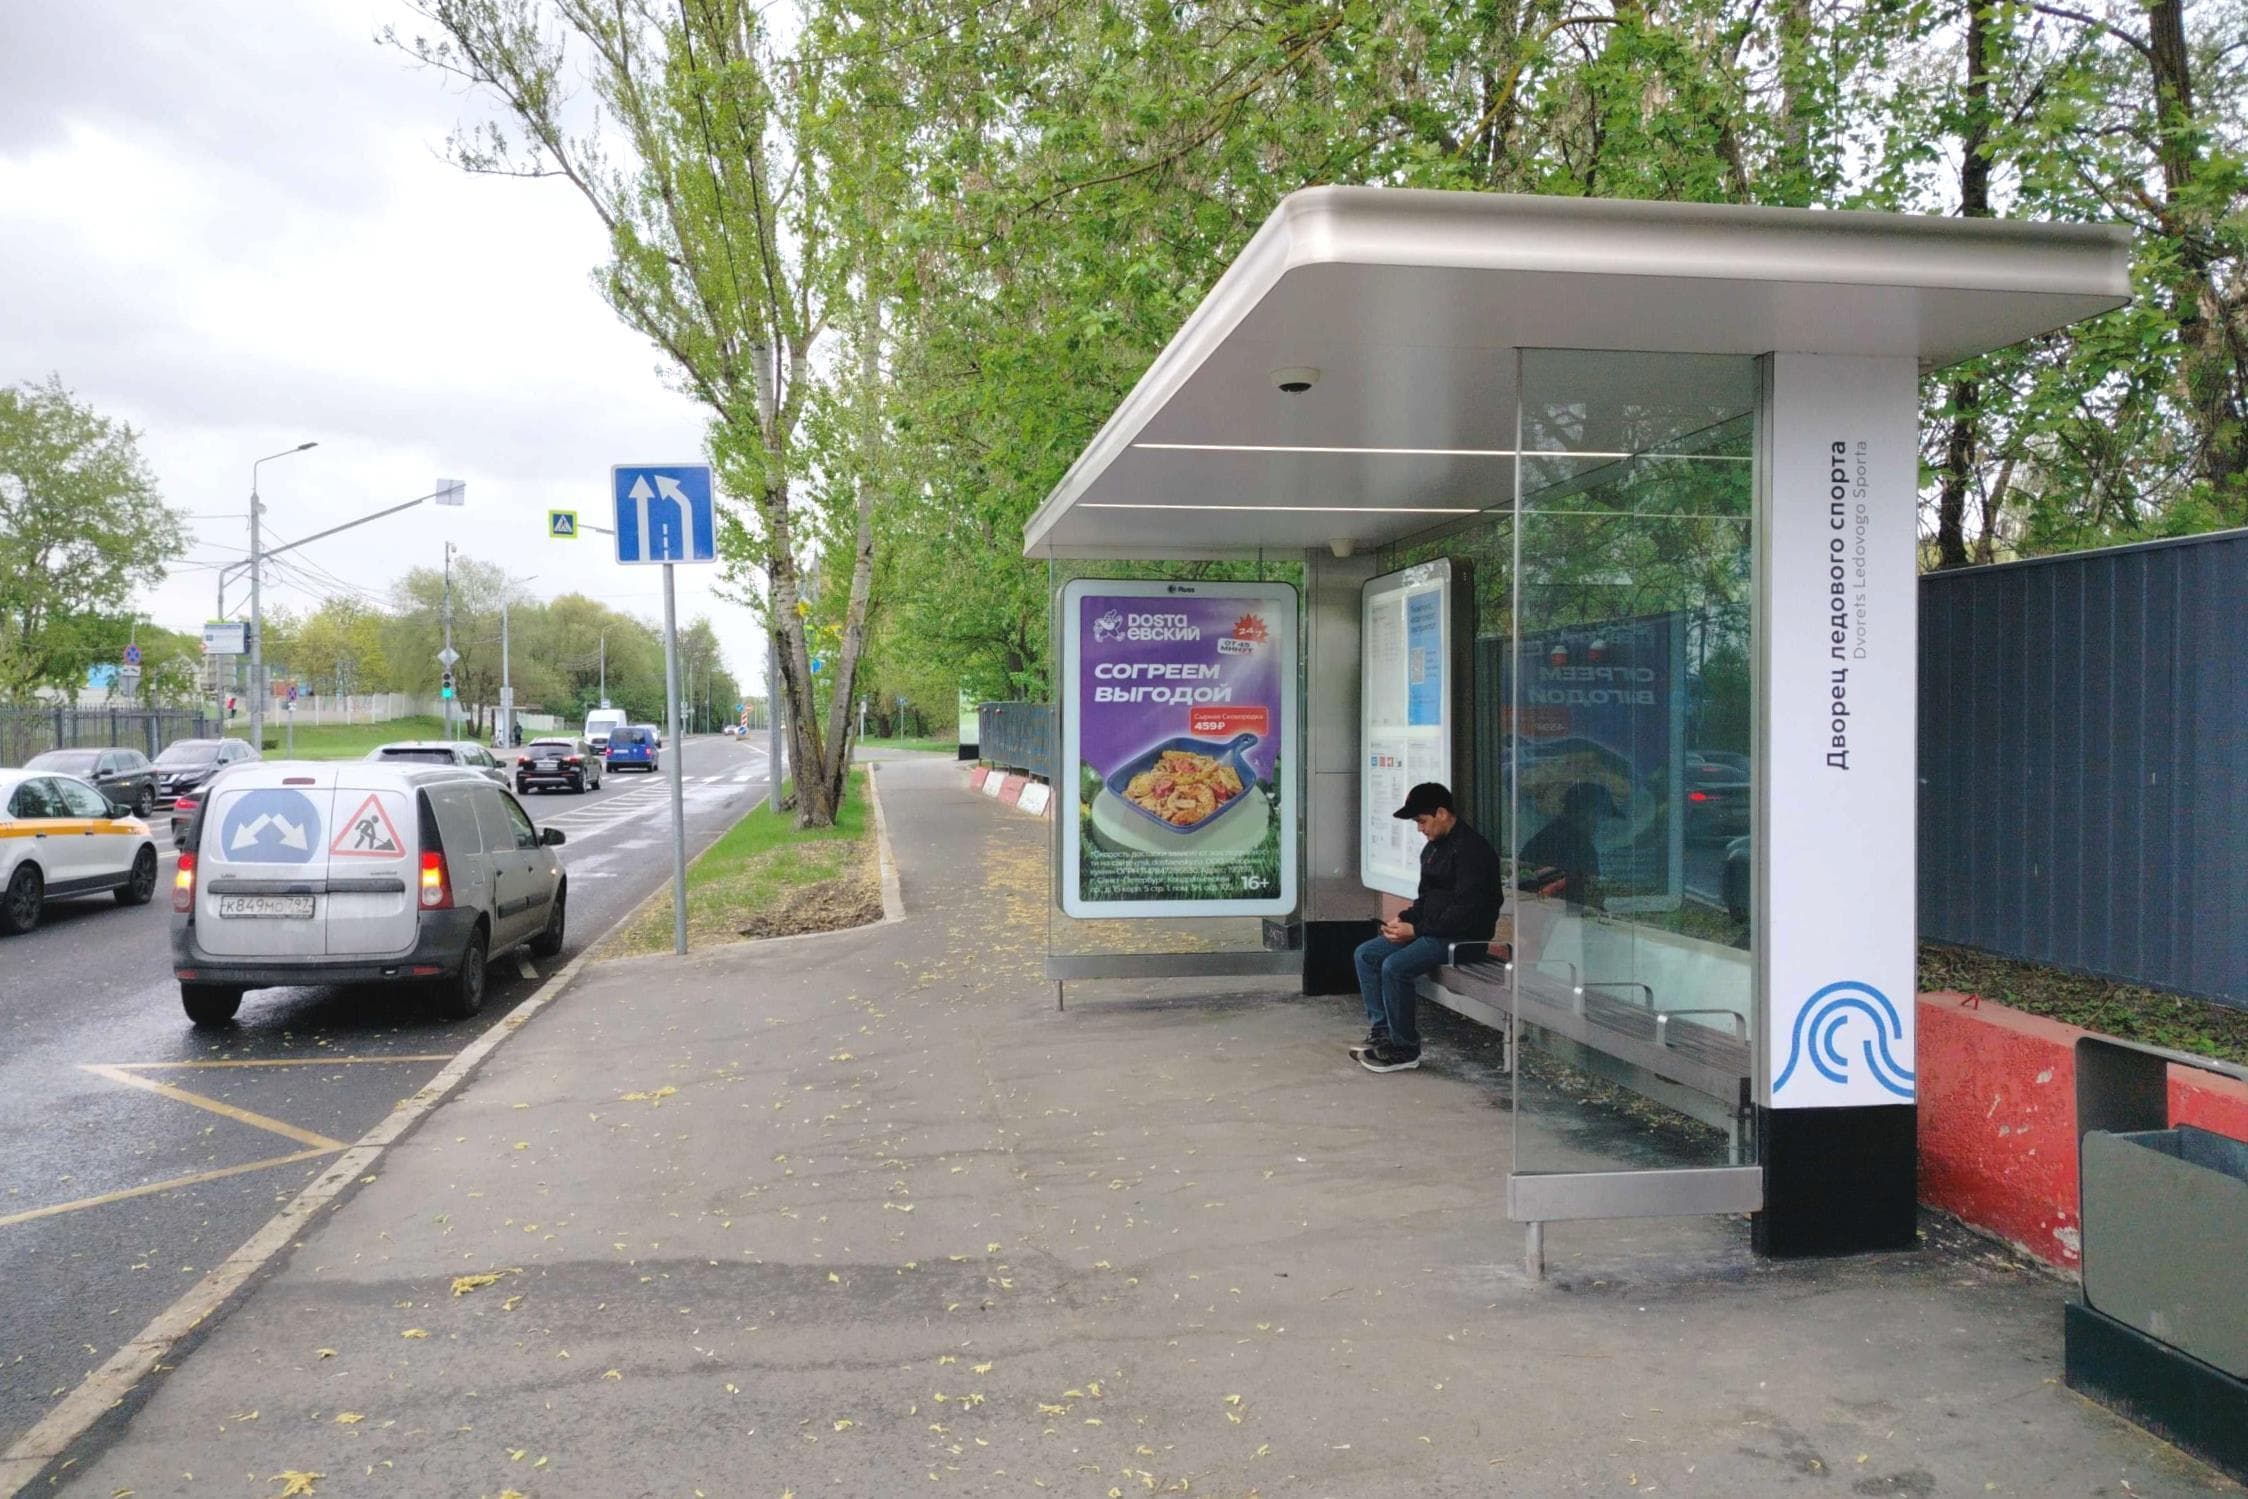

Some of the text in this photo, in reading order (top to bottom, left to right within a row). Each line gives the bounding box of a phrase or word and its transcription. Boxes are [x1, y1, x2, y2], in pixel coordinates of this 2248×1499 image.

[1853, 440, 1869, 660] Dvorets Ledovogo Sporta
[1826, 440, 1850, 771] Дворец ледового спорта
[1094, 663, 1221, 680] СОГРЕЕМ
[1094, 683, 1233, 705] ВЫГОДОЙ
[1240, 875, 1270, 890] 16+
